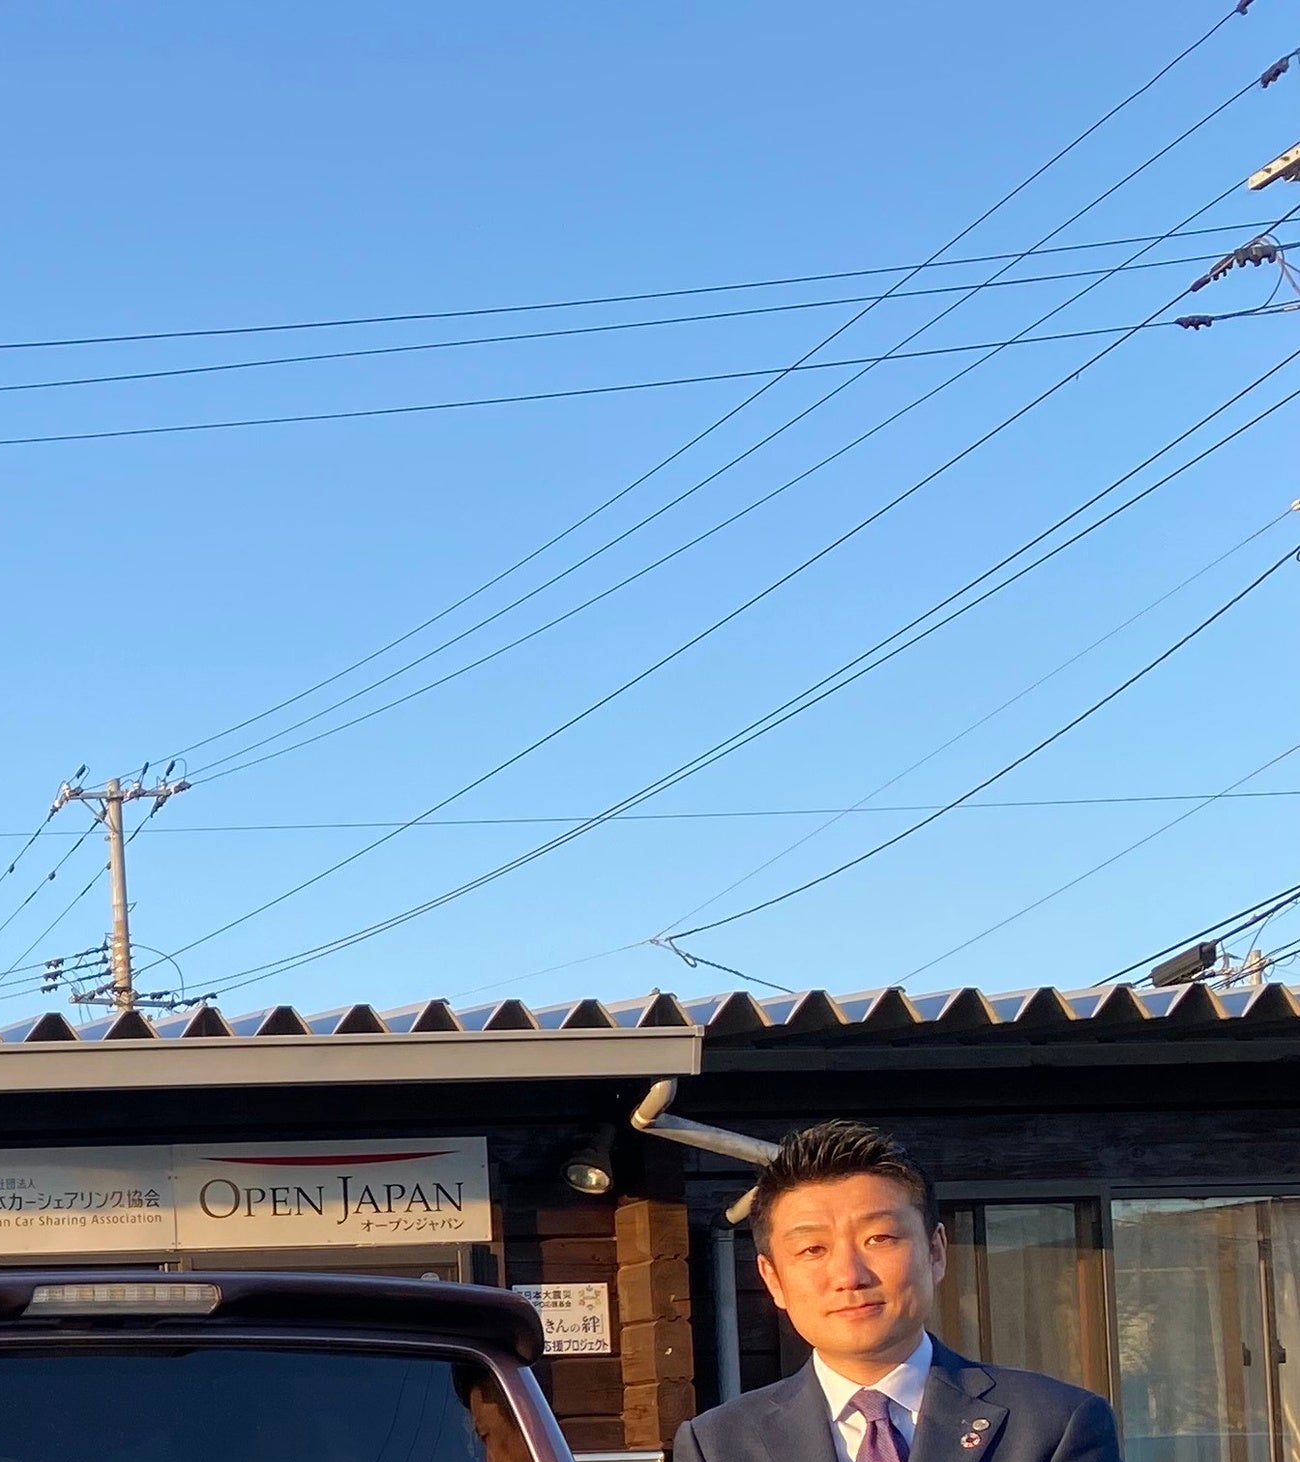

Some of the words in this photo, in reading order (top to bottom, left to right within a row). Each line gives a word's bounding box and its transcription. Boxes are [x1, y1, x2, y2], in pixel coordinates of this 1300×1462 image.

[15, 1214, 34, 1227] Car
[38, 1212, 86, 1228] Sharing
[91, 1211, 162, 1225] Association
[360, 1216, 465, 1232] オープンジャパン
[517, 1289, 572, 1300] 日本大震災
